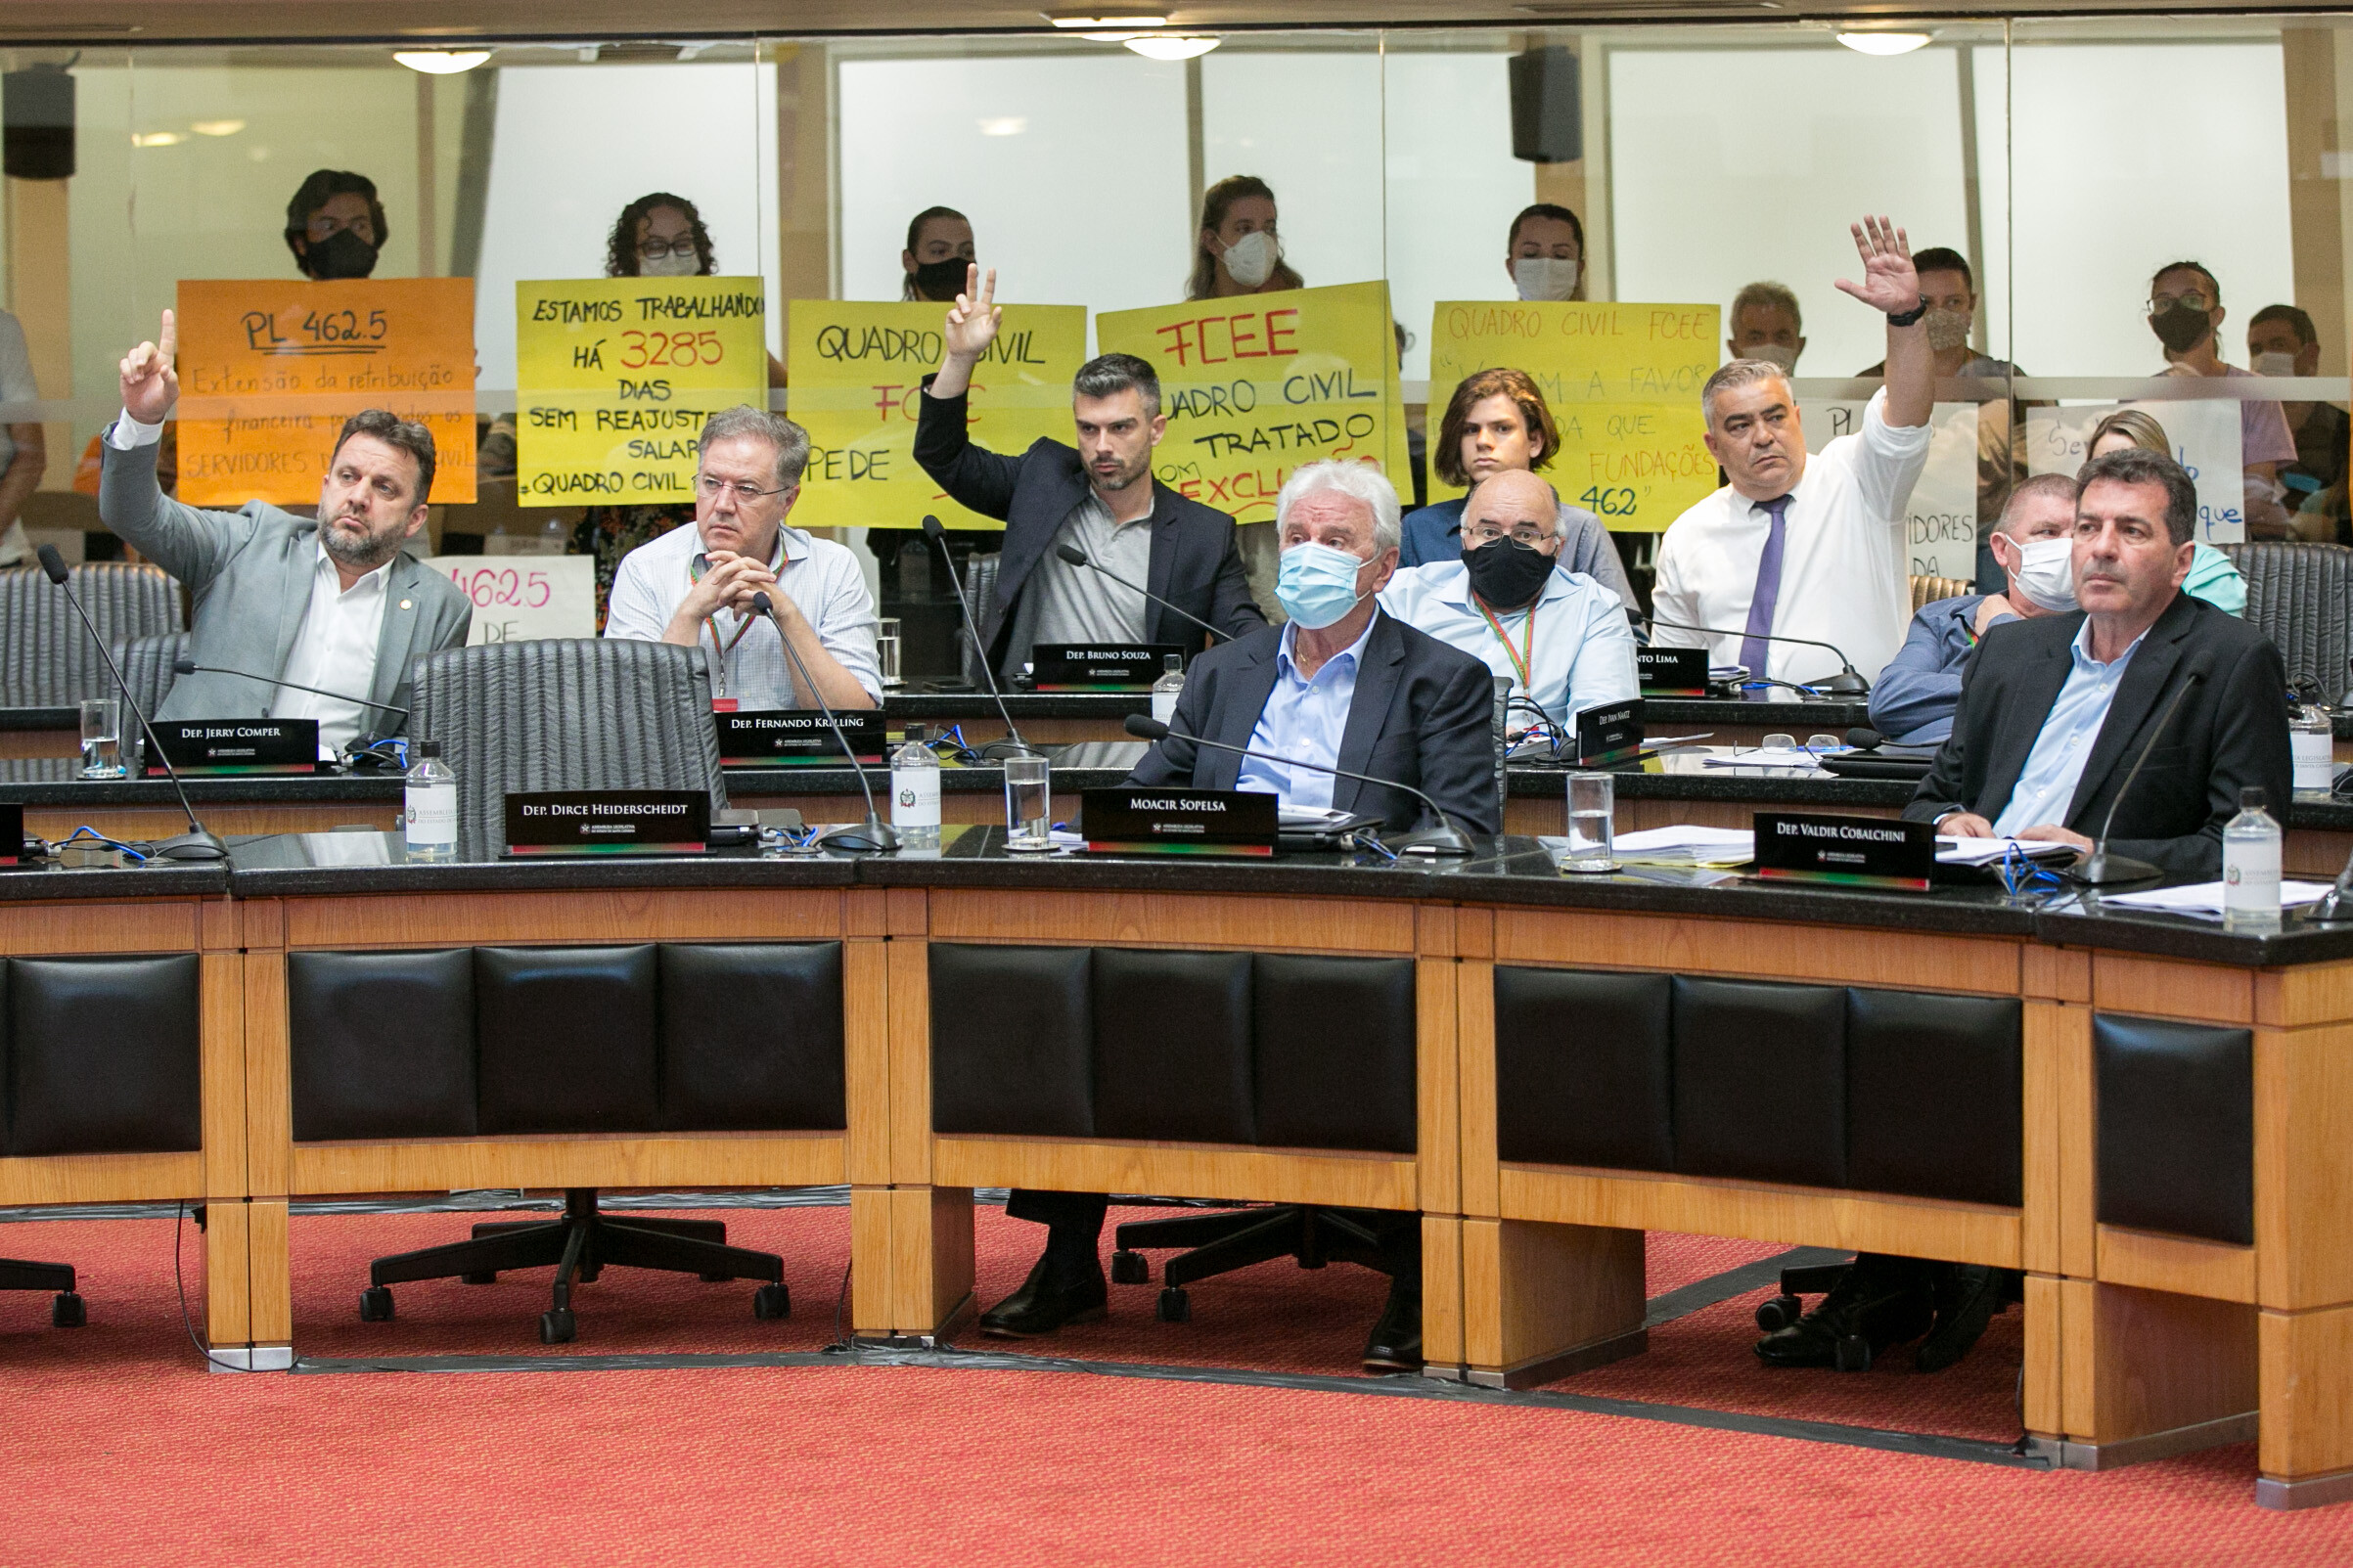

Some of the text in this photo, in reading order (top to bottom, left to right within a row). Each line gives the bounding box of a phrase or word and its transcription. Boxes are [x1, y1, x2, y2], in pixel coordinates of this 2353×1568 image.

[532, 299, 622, 323] ESTAMOS
[241, 311, 287, 349] PL
[1449, 306, 1711, 341] QUADRO CIVIL FCEE
[573, 330, 724, 370] HÁ 3285
[817, 325, 942, 364] QUADRO
[1155, 309, 1299, 367] FCEE
[315, 366, 338, 388] da
[1284, 368, 1377, 405] CIVIL
[1587, 371, 1606, 398] A
[1629, 363, 1707, 393] FAVOR
[617, 380, 672, 402] DIAS
[529, 407, 576, 431] SEM
[1607, 415, 1656, 439] QUE
[1194, 413, 1376, 458] TRATADO
[628, 440, 700, 460] SALAR
[186, 451, 307, 480] SERVIDORES
[807, 445, 889, 481] PEDE
[1158, 461, 1202, 483] OM
[1590, 444, 1716, 483] FUNDAÇÕES
[632, 472, 687, 491] CIVIL
[1908, 514, 1974, 546] IDORES
[2198, 505, 2243, 541] que
[1066, 650, 1152, 660] DEP. BRUNO SOUZA
[1655, 654, 1679, 664] LIMA
[181, 727, 282, 739] DEP. JERRY COMPER
[731, 717, 864, 729] DEP. FERNANDO KRLLING
[522, 803, 689, 817] DEP. DIRCE HEIDERSCHEIDT
[1130, 798, 1227, 812] MOACIR SOPELSA
[1777, 821, 1906, 842] DEP. VALDIR COBALCHINI
